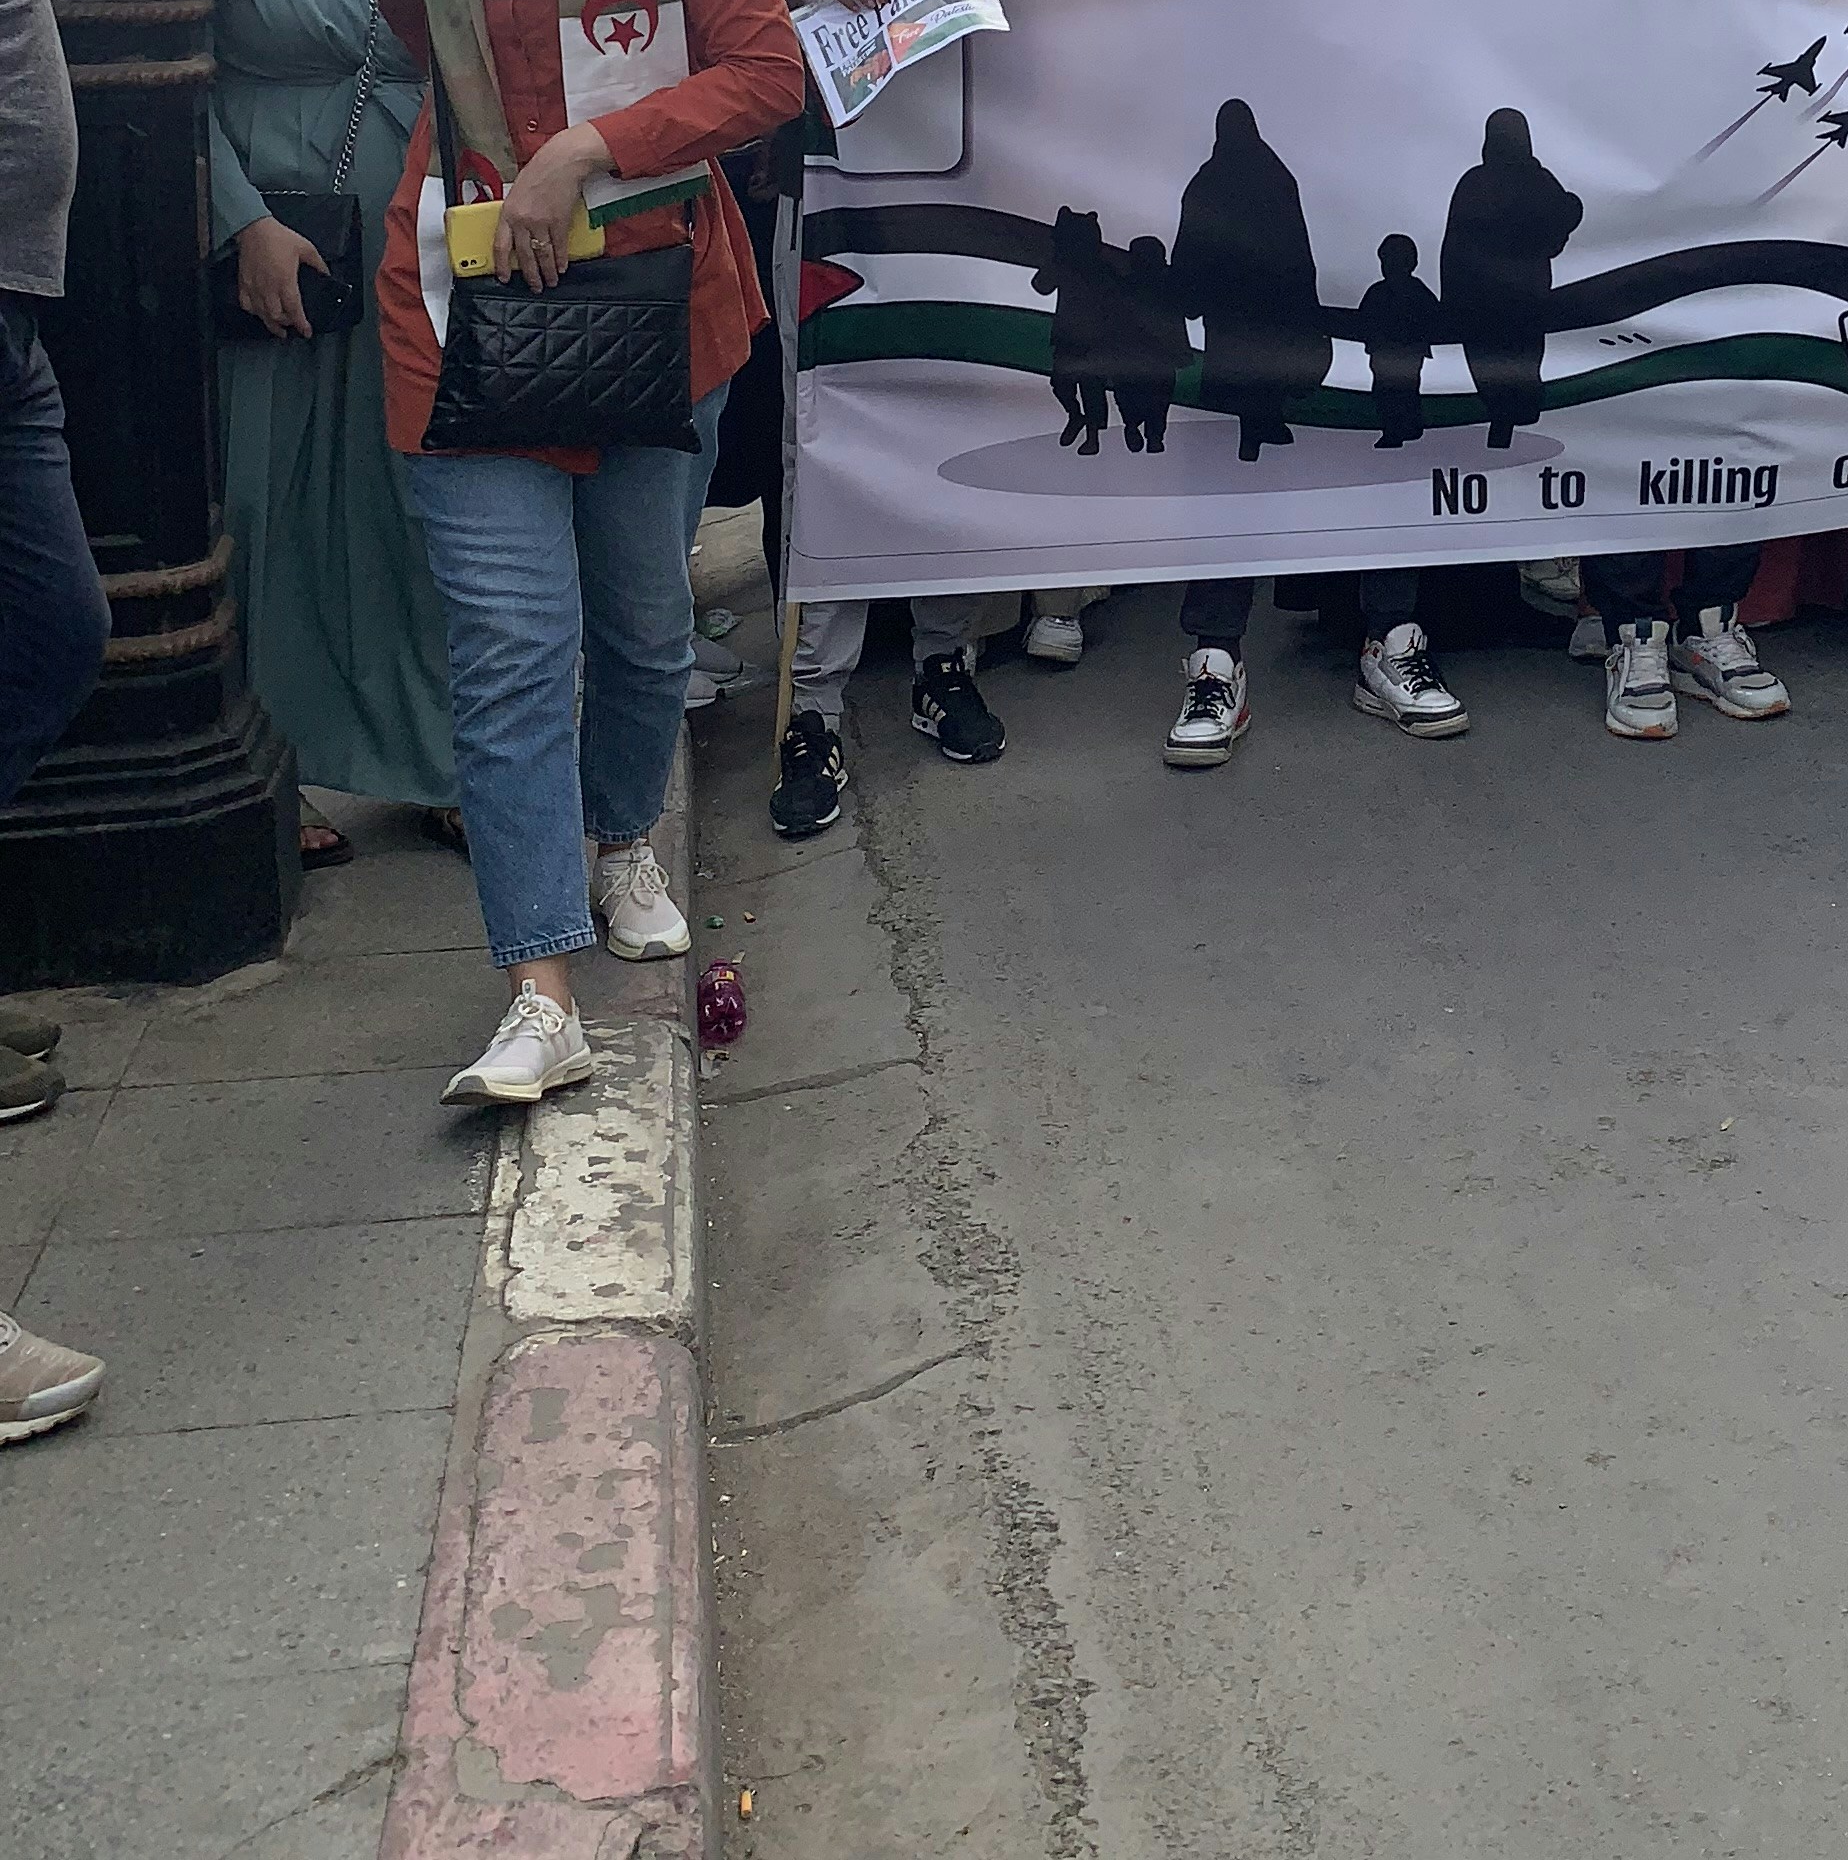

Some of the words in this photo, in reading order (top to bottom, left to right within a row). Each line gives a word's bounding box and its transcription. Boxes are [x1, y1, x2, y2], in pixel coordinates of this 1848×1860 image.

[811, 10, 870, 69] Free
[1431, 466, 1488, 516] No
[1539, 464, 1586, 511] to
[1639, 455, 1779, 509] killing
